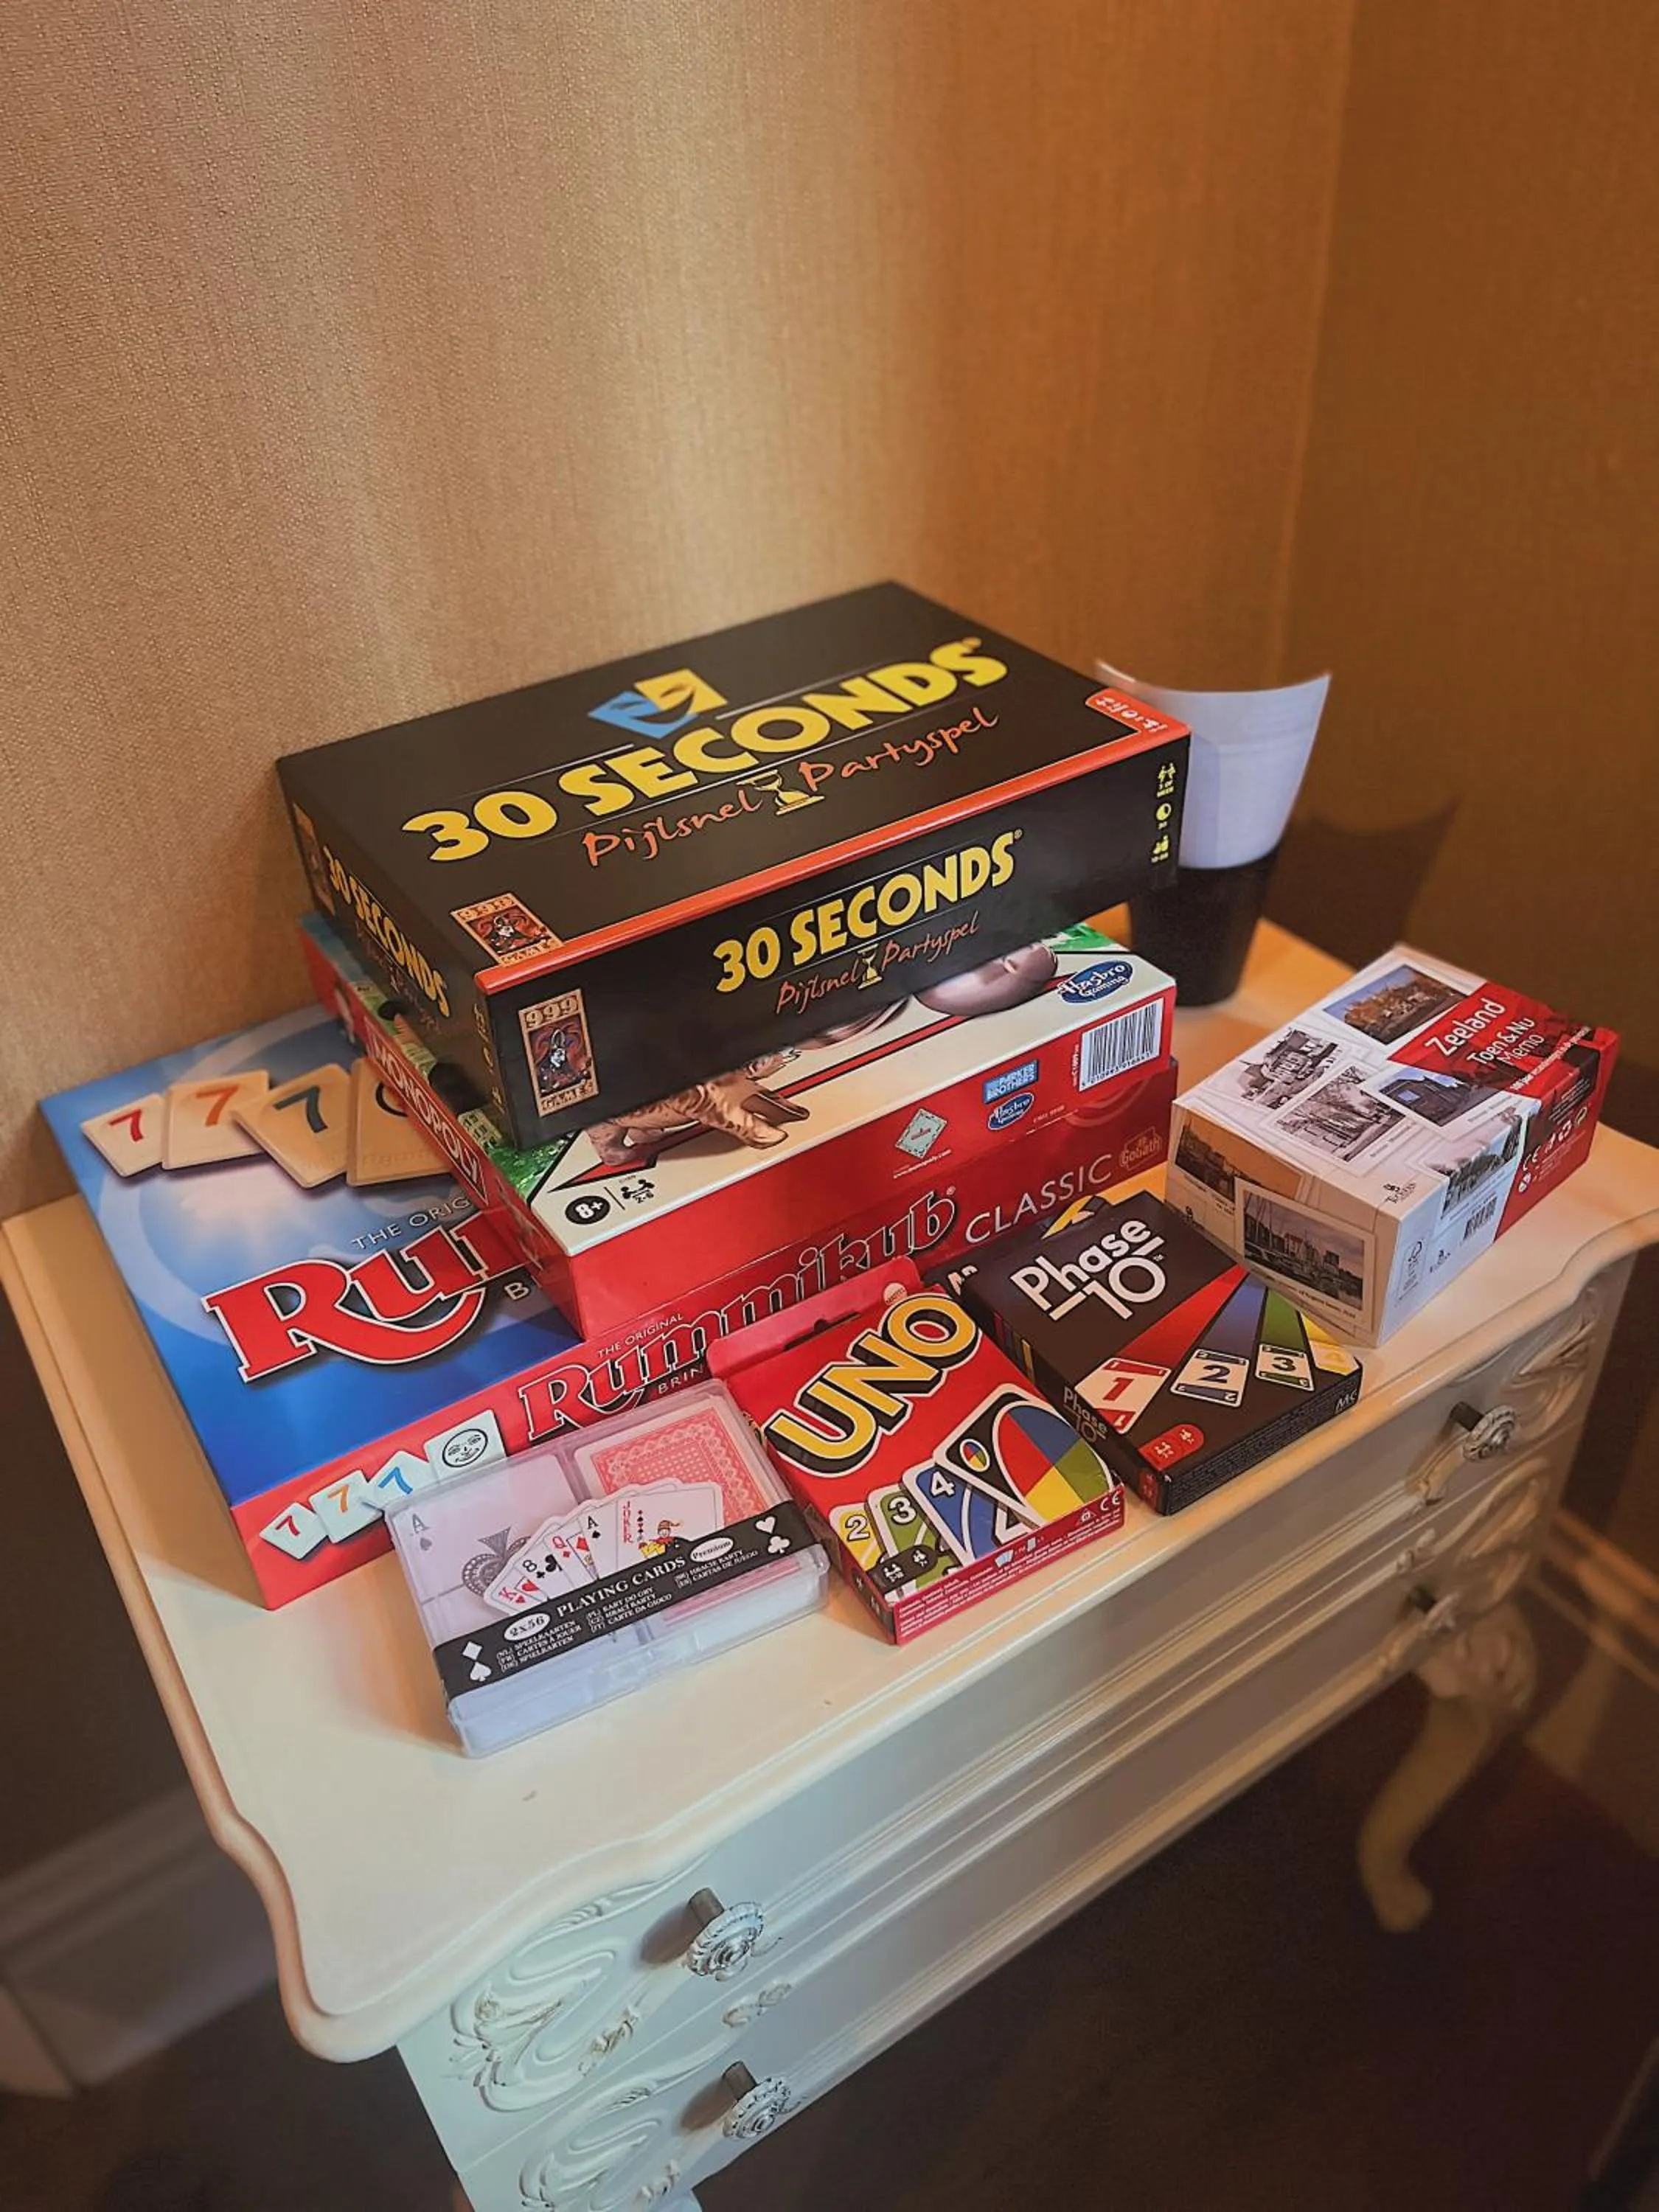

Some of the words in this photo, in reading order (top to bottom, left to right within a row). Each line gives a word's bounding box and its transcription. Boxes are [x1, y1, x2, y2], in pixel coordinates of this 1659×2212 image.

[402, 790, 558, 861] 30
[558, 640, 1008, 818] SECONDS
[582, 789, 764, 867] Pijlsnel
[797, 707, 1001, 796] Partyspel
[713, 927, 782, 994] 30
[791, 830, 1016, 967] SECONDS
[349, 876, 451, 1018] SECONDS
[775, 962, 860, 1015] Pijlsnel
[879, 912, 981, 971] Partyspel
[1057, 963, 1126, 995] Hasbro
[525, 996, 579, 1029] 999
[1425, 998, 1506, 1056] Zeeland
[1467, 1039, 1503, 1064] Toen
[1506, 1018, 1536, 1037] Nu
[1498, 1034, 1545, 1065] Memo
[195, 1084, 240, 1127] 7
[274, 1085, 328, 1133] 7
[540, 1082, 594, 1111] GAMES
[109, 1109, 145, 1143] 7
[575, 1200, 604, 1219] 8+
[965, 1154, 1112, 1244] CLASSIC
[351, 1223, 402, 1251] THE
[408, 1195, 470, 1230] ORIG
[1009, 1219, 1151, 1312] Phase
[1081, 1250, 1166, 1321] 10
[597, 1340, 621, 1358] THE
[625, 1312, 684, 1347] ORIGINAL
[658, 1364, 706, 1395] BRIN
[1202, 1364, 1231, 1384] 2
[1271, 1356, 1296, 1373] 3
[764, 1293, 981, 1478] UNO
[1103, 1377, 1134, 1401] 1
[1063, 1386, 1108, 1435] Phase
[378, 1466, 413, 1495] 7
[930, 1470, 957, 1499] 4
[328, 1484, 350, 1514] 7
[888, 1495, 918, 1526] 3
[275, 1515, 300, 1537] 7
[410, 1514, 430, 1536] A
[587, 1515, 599, 1530] A
[845, 1514, 871, 1542] 2
[521, 1559, 538, 1573] 8
[557, 1579, 629, 1618] PLAYING
[632, 1556, 686, 1586] CARDS
[608, 1609, 635, 1625] CARTE
[517, 1637, 549, 1658] CARTES
